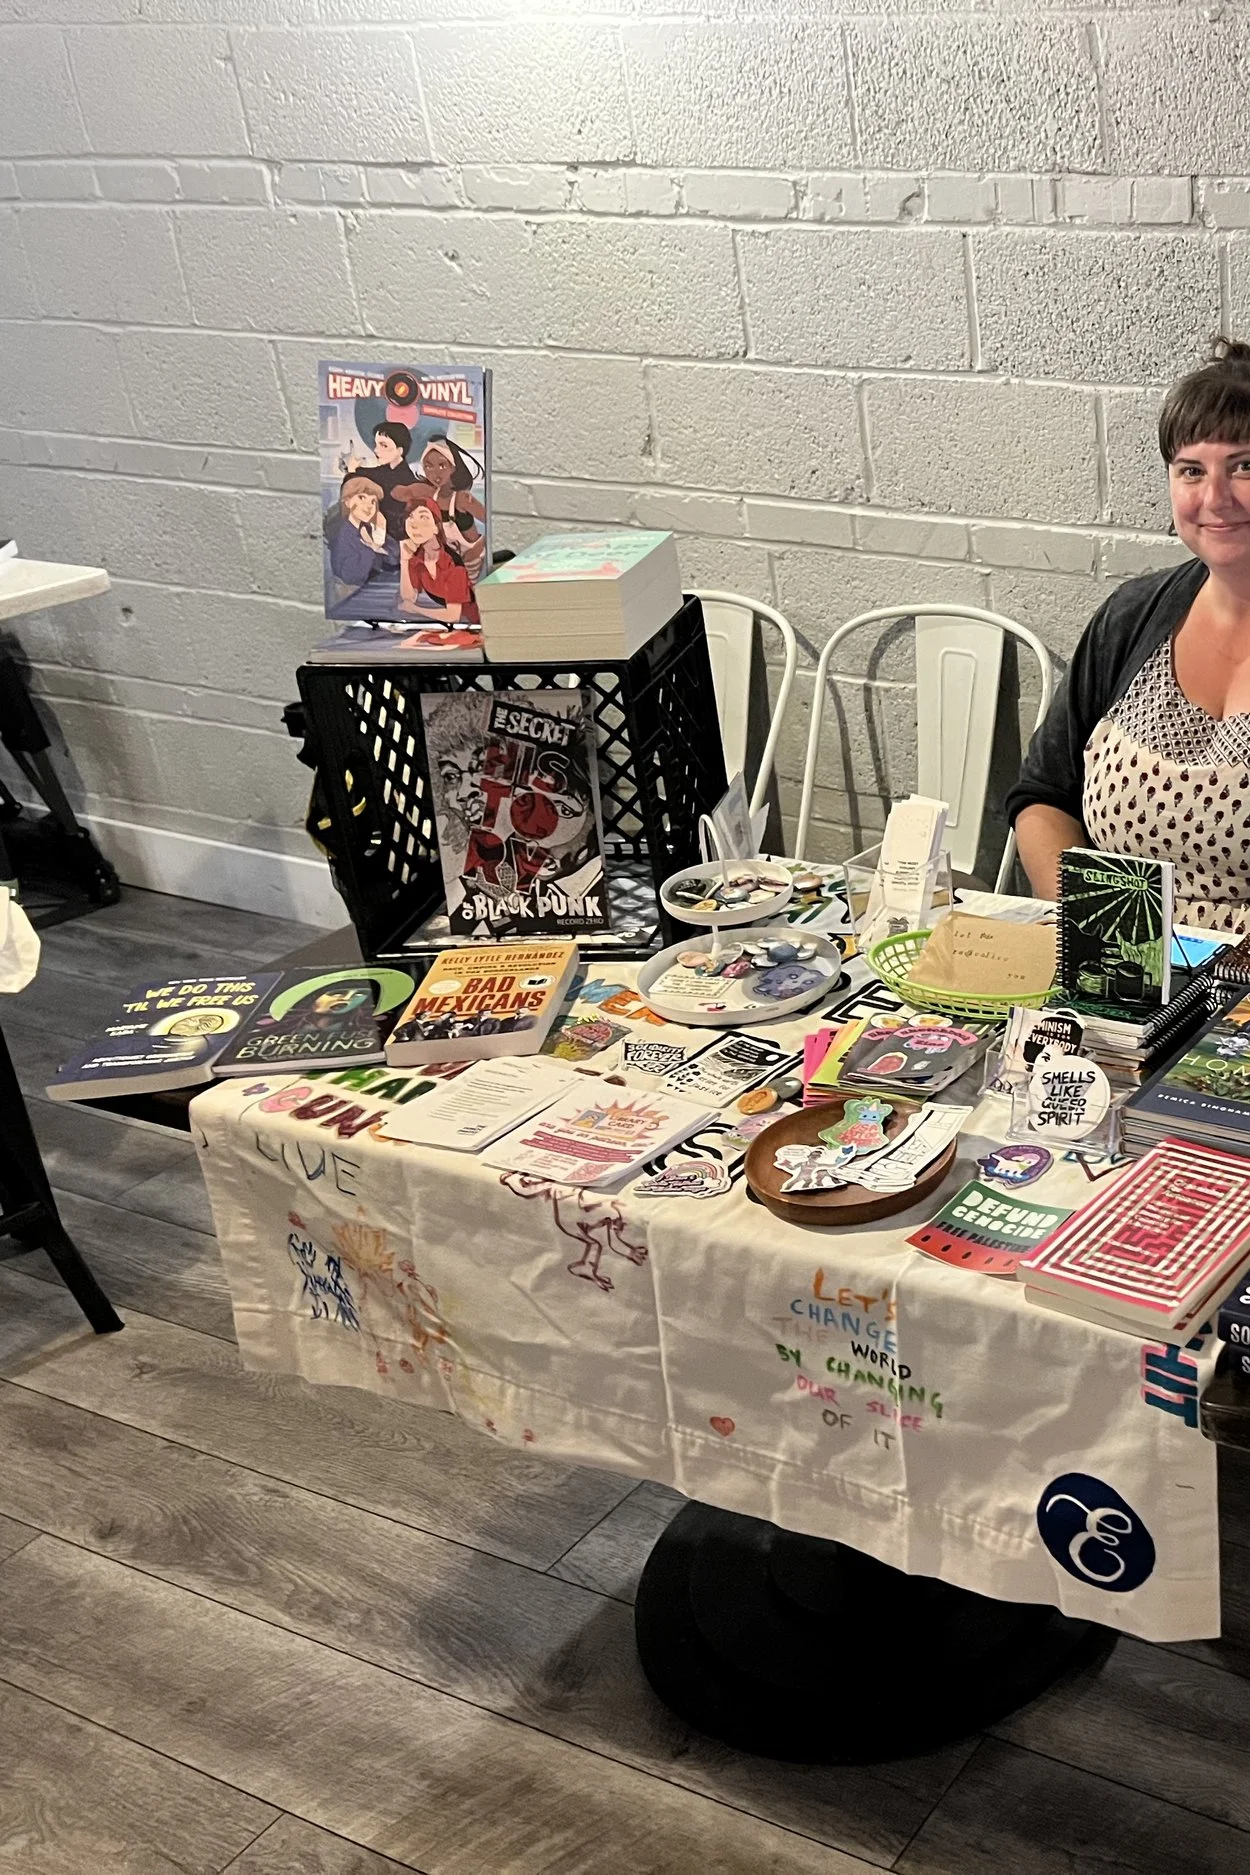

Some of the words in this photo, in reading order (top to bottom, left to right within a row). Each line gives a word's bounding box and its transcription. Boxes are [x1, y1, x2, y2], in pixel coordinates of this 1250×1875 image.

[328, 373, 384, 399] HEAVY
[419, 380, 472, 405] VINYL
[494, 706, 508, 729] THE
[507, 709, 577, 746] SECRET
[1085, 870, 1148, 889] SLINGSHOT
[462, 902, 475, 920] OF
[473, 894, 534, 921] BLACK
[537, 893, 602, 919] PUNK
[441, 956, 473, 965] KELLY
[473, 954, 502, 963] LYTLE
[146, 986, 175, 999] WE
[178, 984, 208, 996] DO
[214, 982, 256, 994] THIS
[462, 976, 516, 994] BAD
[156, 997, 186, 1009] WE
[187, 995, 232, 1007] FREE
[231, 994, 259, 1006] US
[411, 990, 547, 1017] MEXICANS
[235, 1038, 377, 1059] BURNING
[247, 1032, 320, 1047] GREEN
[627, 1043, 684, 1054] SOLIDARITY
[627, 1051, 682, 1061] FOREVER
[1042, 1071, 1096, 1085] SMELLS
[1050, 1085, 1083, 1098] LIKE
[1037, 1111, 1085, 1127] SPIRIT
[962, 1189, 1060, 1229] DEFUND
[951, 1206, 1047, 1240] GENOCIDE
[937, 1220, 967, 1237] FREE
[969, 1231, 1034, 1254] PALESTINE
[812, 1267, 898, 1322] LET'S
[790, 1299, 897, 1354] CHANGE
[1230, 1322, 1250, 1347] SO
[773, 1316, 829, 1343] THE
[850, 1341, 912, 1381] WORLD
[775, 1343, 803, 1368] BY
[826, 1356, 944, 1419] CHANGING
[796, 1374, 842, 1409] OUR
[865, 1401, 924, 1432] SLICE
[822, 1408, 853, 1429] OF
[873, 1429, 896, 1450] IT
